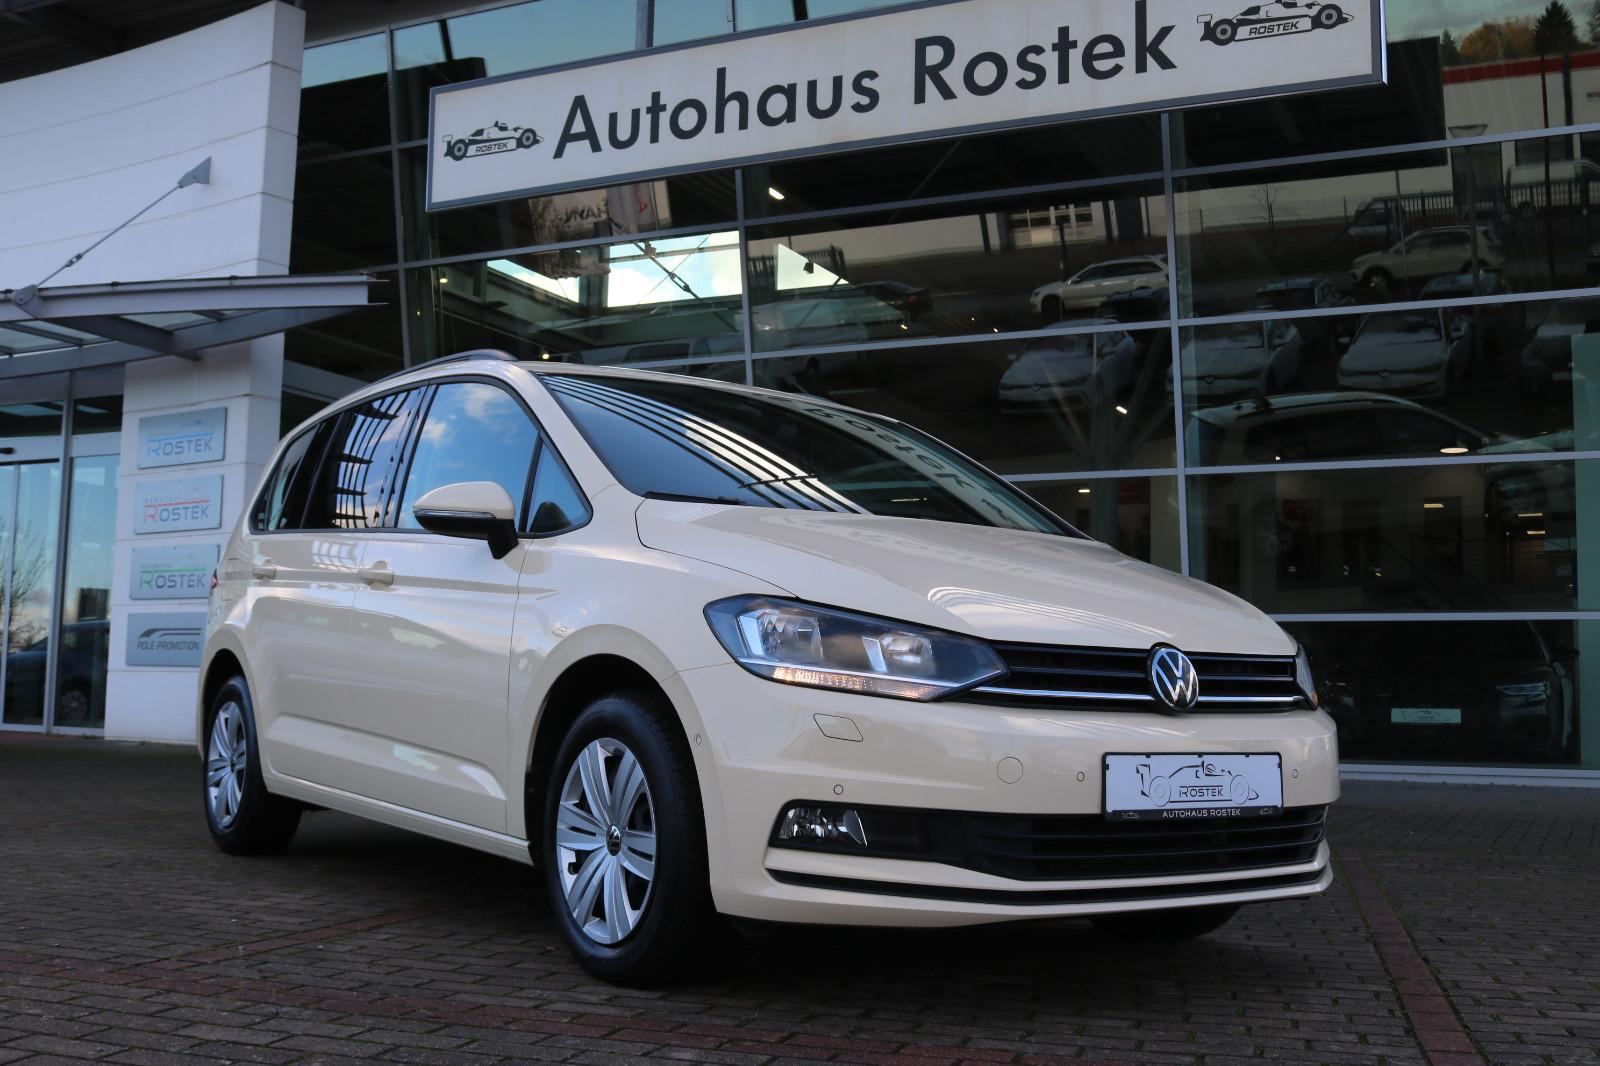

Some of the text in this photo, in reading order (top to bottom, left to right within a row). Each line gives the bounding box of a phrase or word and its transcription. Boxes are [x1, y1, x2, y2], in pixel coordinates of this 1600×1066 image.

[1248, 20, 1300, 37] ROSTEK
[552, 0, 1178, 160] Autohaus Rostek
[475, 142, 509, 153] ROSTEK
[147, 436, 214, 457] ROSTEK
[144, 504, 210, 523] ROSTEK
[139, 571, 206, 589] ROSTEK
[137, 641, 200, 651] POLE PROMOTION
[1178, 785, 1224, 798] ROSTEK
[1162, 808, 1241, 818] AUTOHAUS ROSTEK
